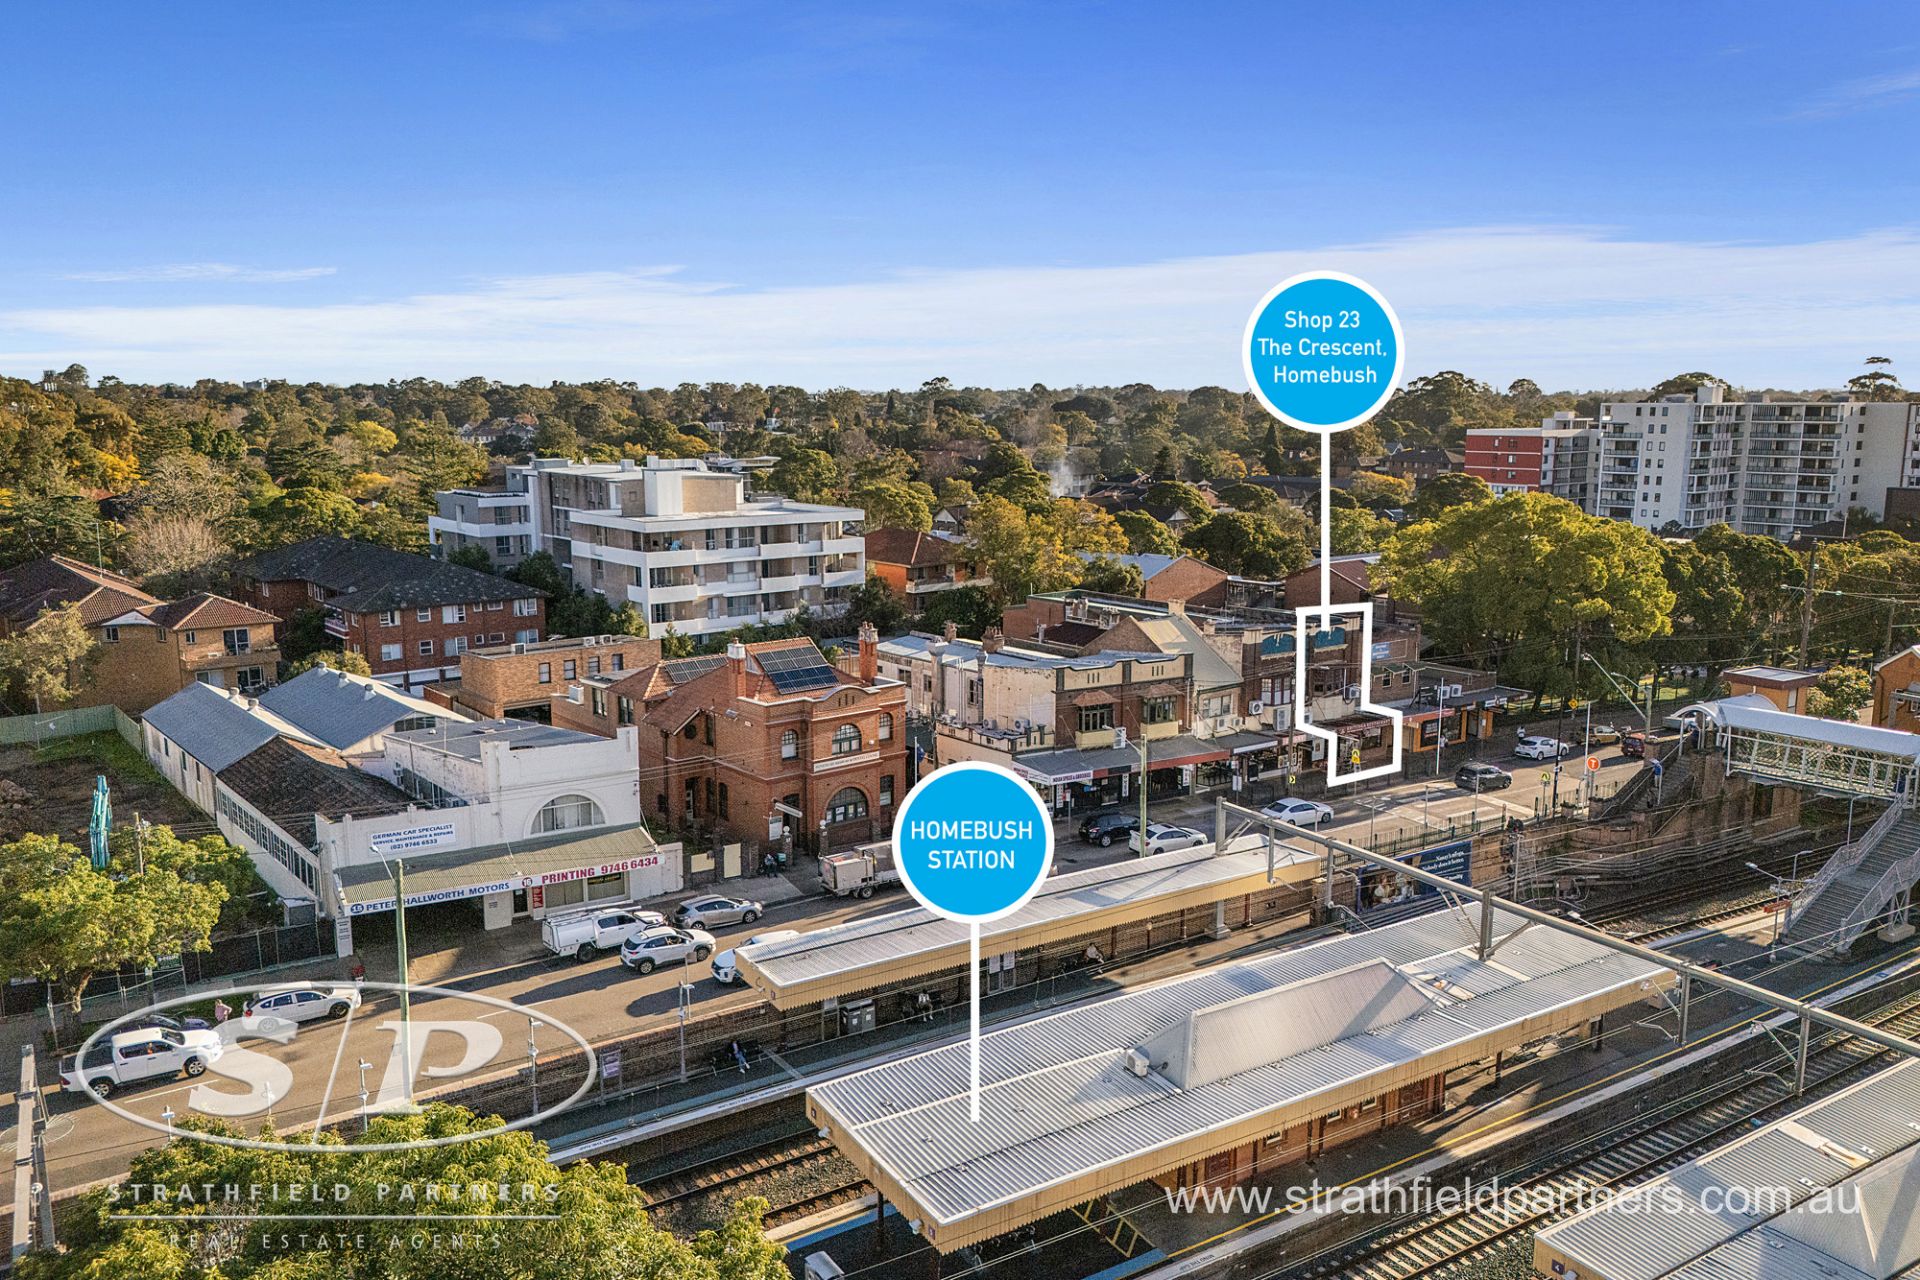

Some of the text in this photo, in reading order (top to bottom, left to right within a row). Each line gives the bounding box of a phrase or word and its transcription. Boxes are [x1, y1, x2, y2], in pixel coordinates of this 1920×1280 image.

[372, 824, 453, 840] GERMAN CAR SPECIALIST
[390, 842, 404, 850] (02)
[404, 840, 420, 848] 9746
[541, 867, 595, 884] PRINTING
[601, 862, 628, 875] 9746
[630, 856, 658, 869] 6434
[366, 902, 397, 912] PETER
[404, 889, 465, 906] HALLWORTH
[468, 882, 510, 896] MOTORS
